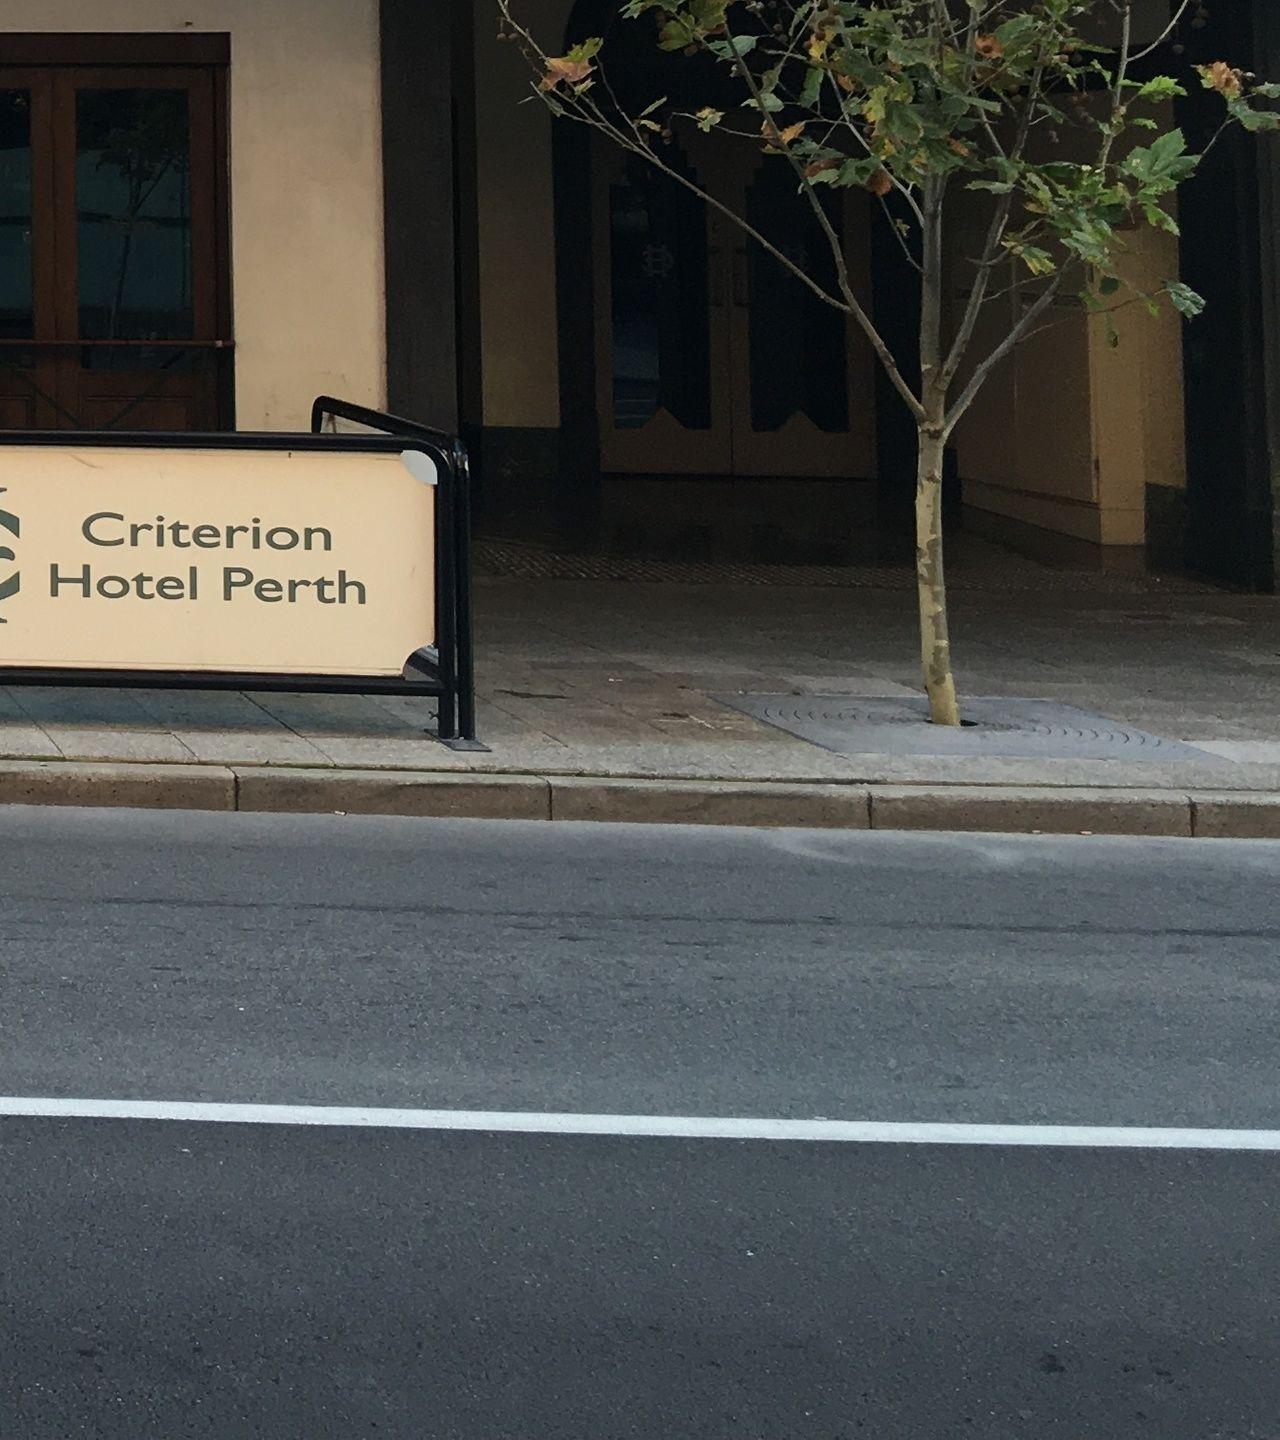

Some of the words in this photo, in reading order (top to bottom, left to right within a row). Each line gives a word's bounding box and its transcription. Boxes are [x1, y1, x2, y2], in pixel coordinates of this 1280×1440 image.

[81, 511, 332, 551] Criterion
[49, 563, 198, 600] Hotel
[222, 566, 367, 604] Perth
